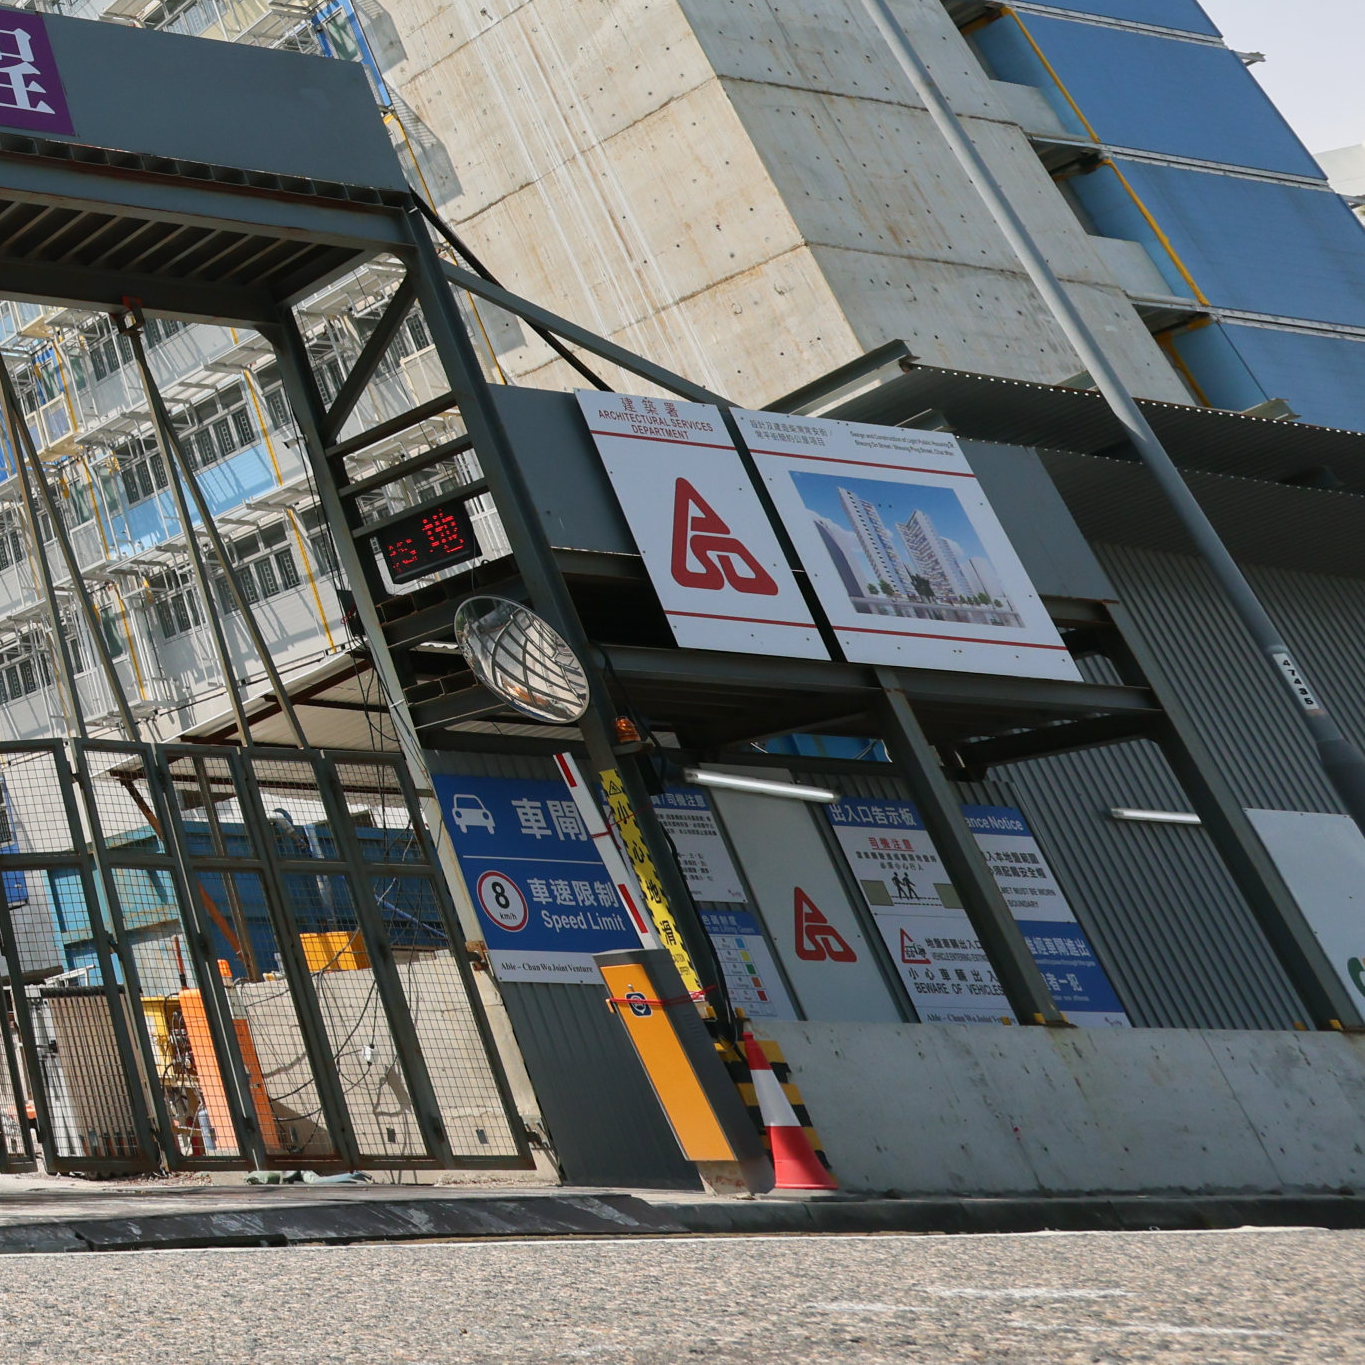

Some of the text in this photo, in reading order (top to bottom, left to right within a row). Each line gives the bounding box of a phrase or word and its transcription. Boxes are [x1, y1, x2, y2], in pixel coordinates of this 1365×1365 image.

[620, 397, 679, 418] 建築署
[598, 409, 714, 432] ARCHITECTURAL SERVICES
[631, 424, 690, 440] DEPARTMENT
[511, 797, 588, 842] 車閘
[829, 803, 917, 826] 出入口告示板
[990, 816, 1024, 831] Notice
[983, 851, 1040, 864] 入本地盤範圍
[617, 800, 677, 946] 小心地滑
[990, 866, 1047, 879] 須配戴安全帽
[491, 881, 510, 909] 8
[527, 877, 620, 908] 車速限制
[499, 912, 518, 921] km/h
[541, 910, 626, 933] Speed Limit
[501, 962, 516, 971] Able
[522, 963, 540, 972] Chun
[540, 963, 552, 972] Wo
[552, 963, 568, 973] Joint
[914, 982, 1005, 996] BEWARE OF VEHICLES
